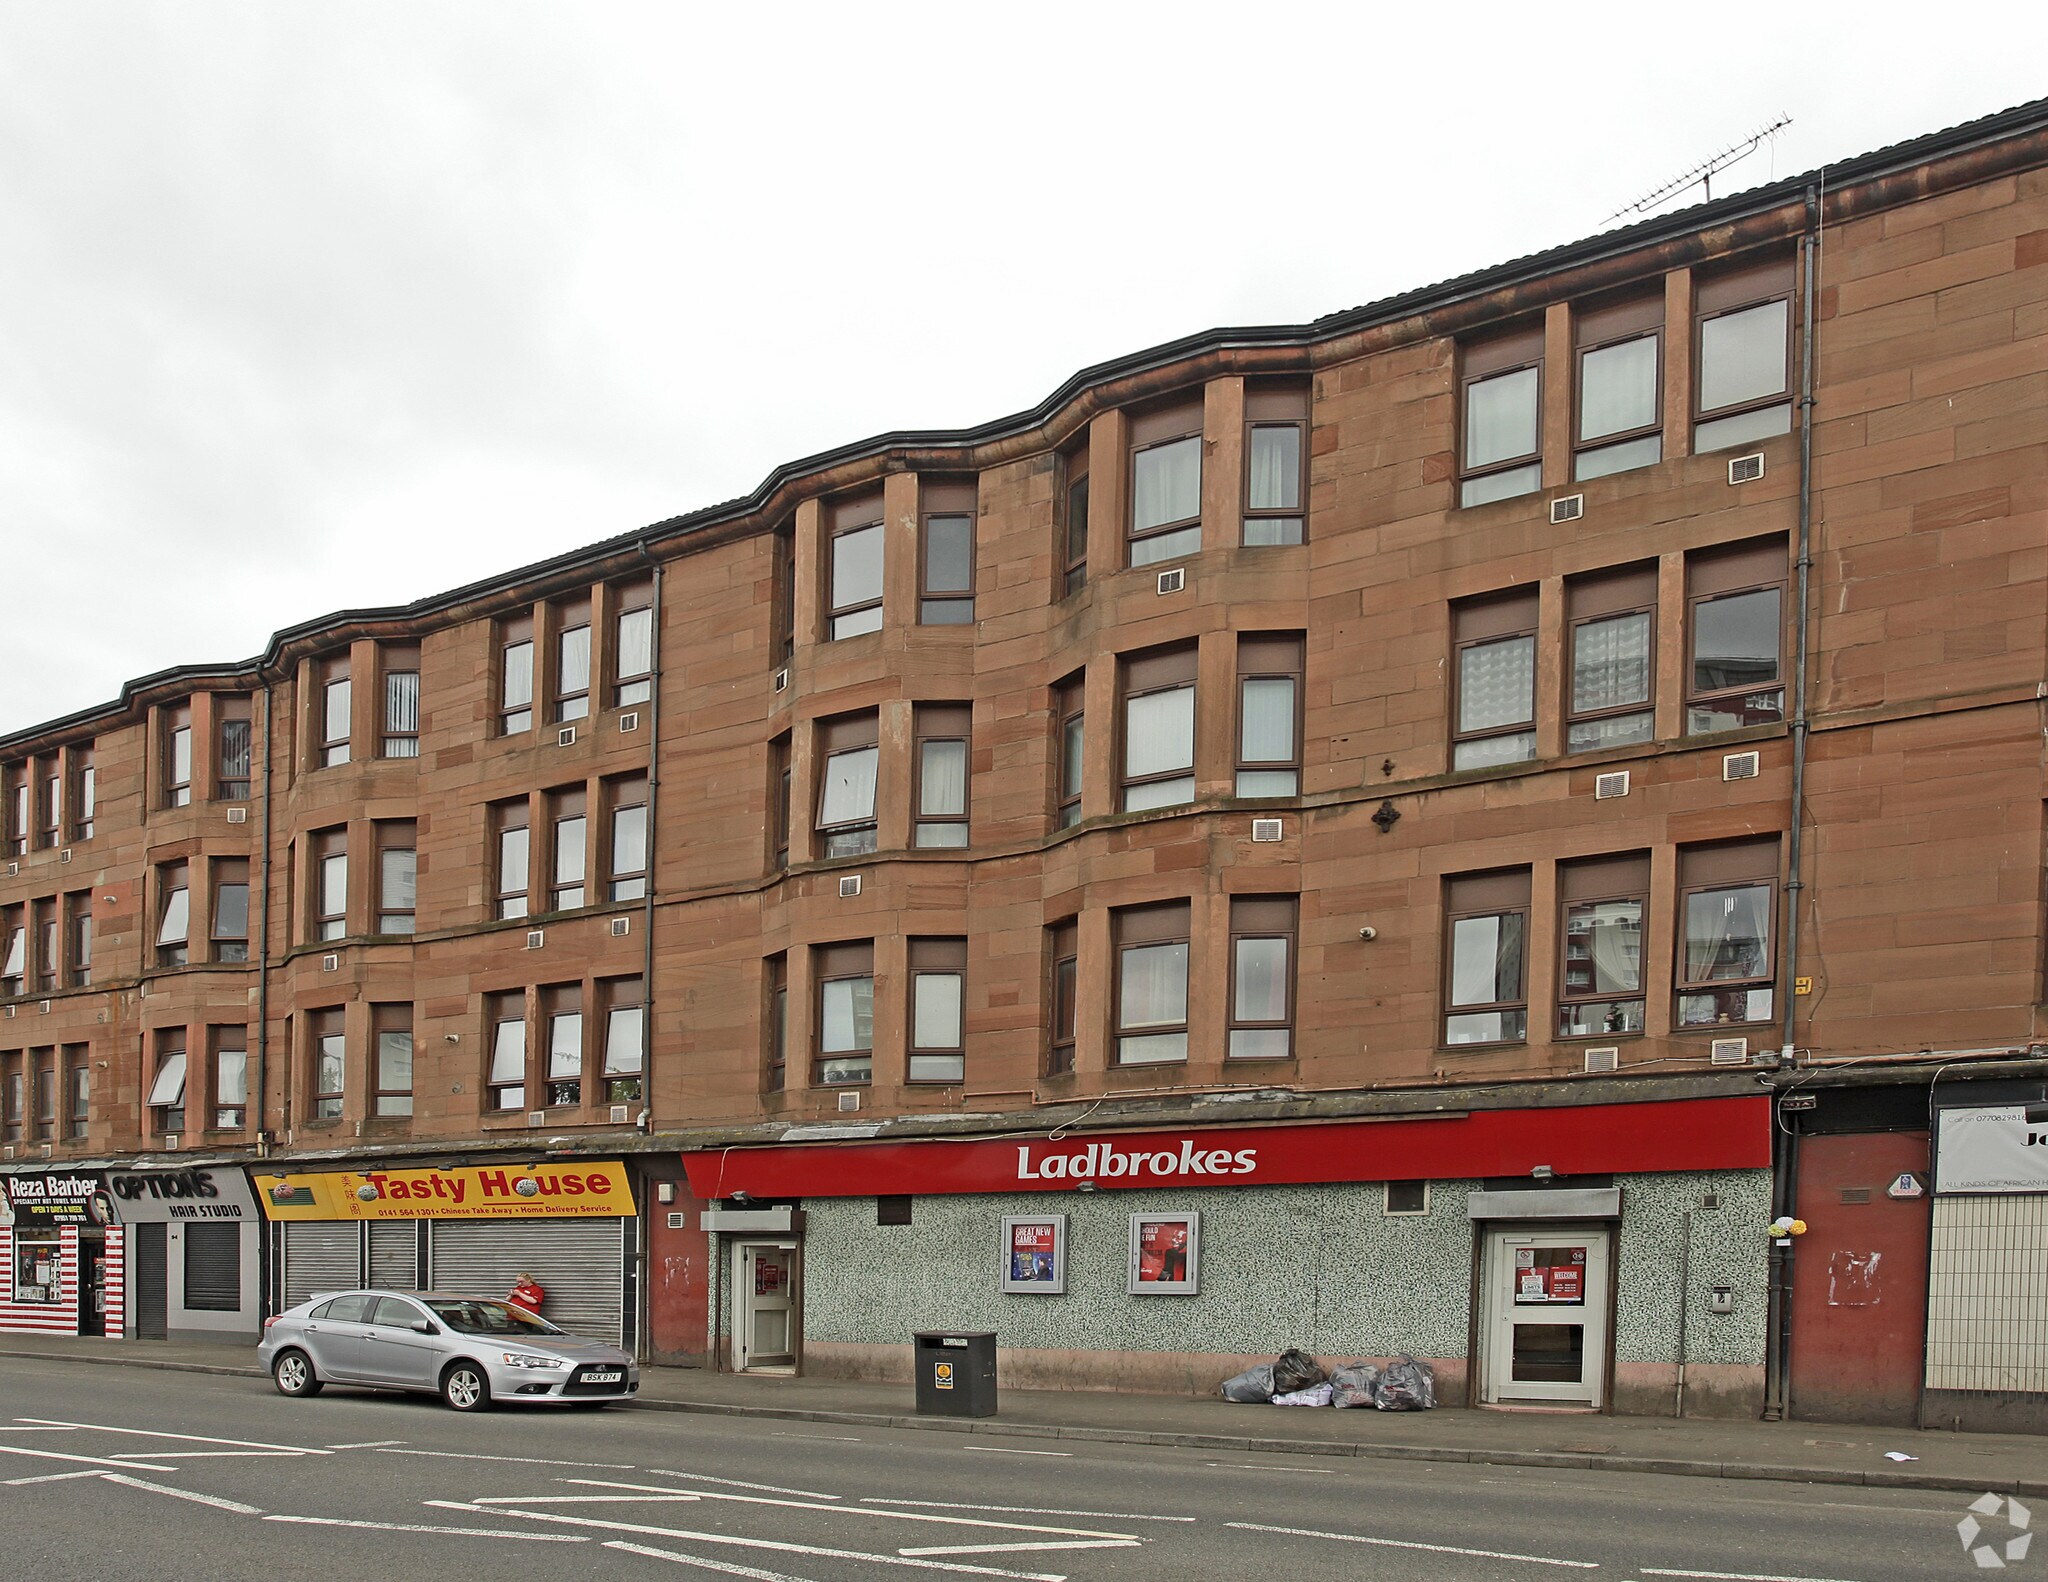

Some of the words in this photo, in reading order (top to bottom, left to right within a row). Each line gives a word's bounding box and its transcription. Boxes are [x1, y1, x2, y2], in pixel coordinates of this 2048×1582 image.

[1017, 1140, 1256, 1179] Ladbrokes
[9, 1177, 46, 1197] Reza
[46, 1176, 98, 1196] Barber
[112, 1172, 218, 1200] OPTIONS
[365, 1174, 465, 1204] Tasty
[169, 1206, 198, 1217] HAIR
[199, 1204, 242, 1217] STUDIO
[492, 1206, 512, 1216] Away
[546, 1205, 580, 1214] Delivery
[580, 1204, 612, 1212] Service
[1015, 1236, 1037, 1244] GAMES
[1016, 1227, 1034, 1236] GREAT
[1035, 1227, 1051, 1236] NEW
